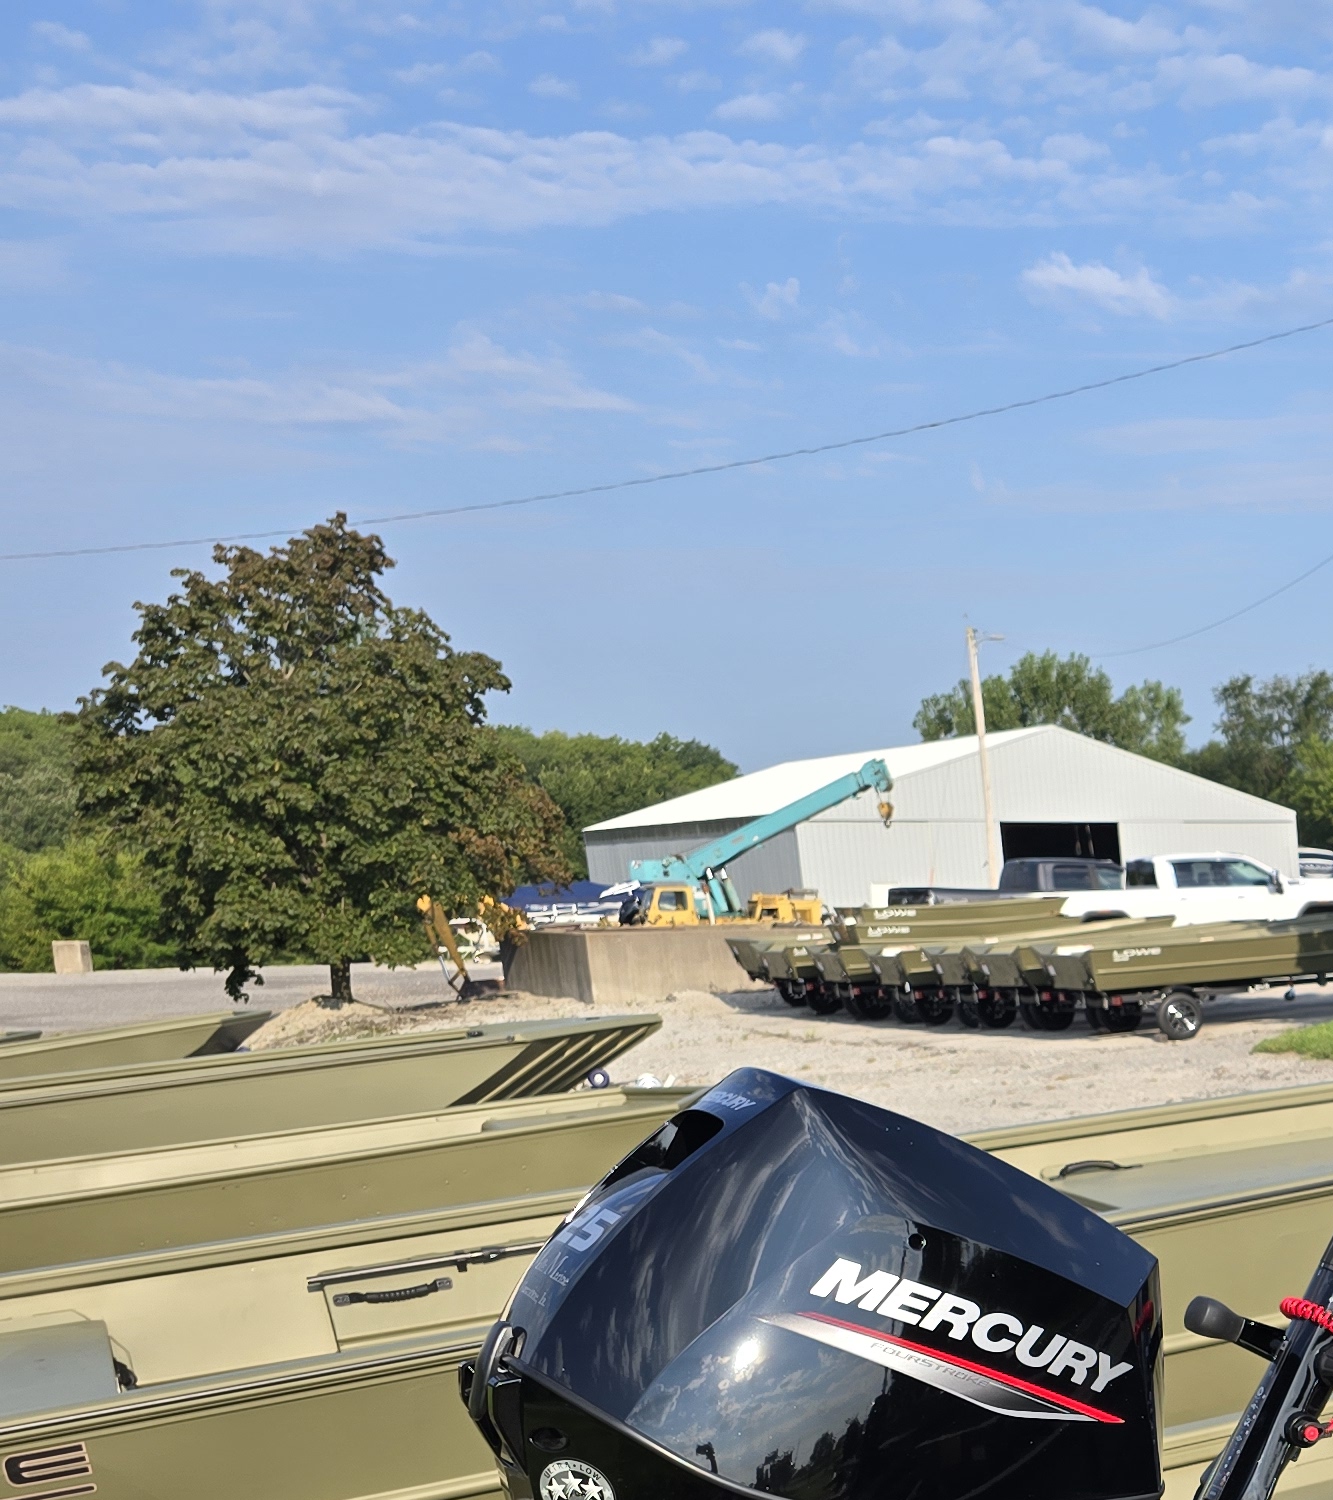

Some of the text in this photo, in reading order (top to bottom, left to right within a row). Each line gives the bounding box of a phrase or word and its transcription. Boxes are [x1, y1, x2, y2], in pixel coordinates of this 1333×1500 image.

[809, 1257, 1134, 1394] MERCURY
[870, 1341, 992, 1389] FOURSTROKE
[579, 1464, 602, 1481] LOW
